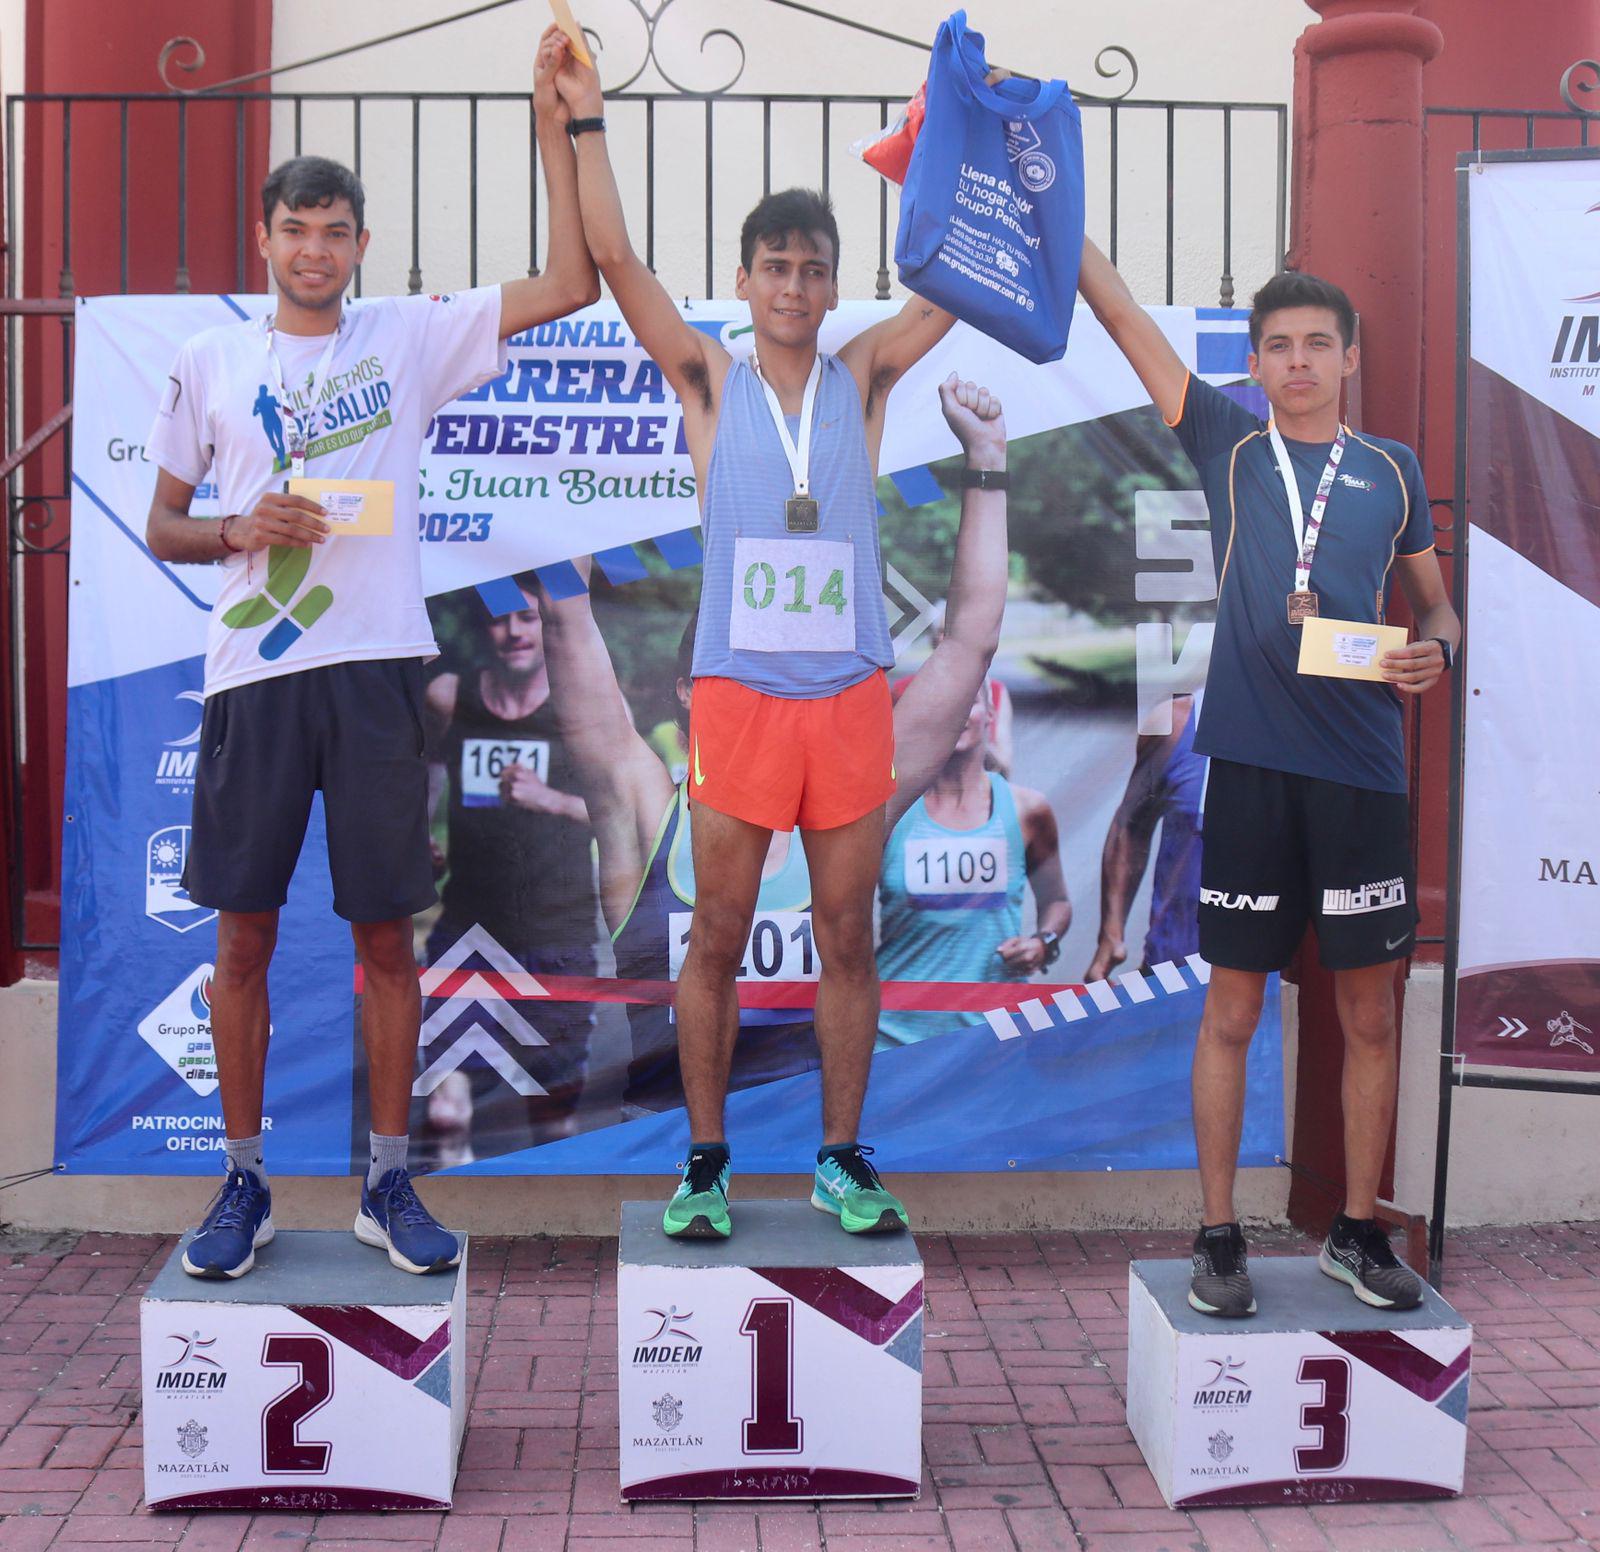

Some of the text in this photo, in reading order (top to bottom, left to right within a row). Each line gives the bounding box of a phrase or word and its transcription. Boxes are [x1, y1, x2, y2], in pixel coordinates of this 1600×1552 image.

[958, 177, 970, 192] tu
[972, 184, 1008, 207] hogar
[960, 163, 996, 187] Llena
[998, 180, 1012, 195] de
[955, 191, 993, 216] Grupo
[323, 381, 391, 431] SALUD
[446, 468, 550, 501] Juan
[743, 562, 848, 616] 014
[470, 745, 539, 779] 1671
[917, 850, 998, 884] 1109
[158, 1023, 195, 1037] Grupo
[187, 1042, 212, 1053] gas
[632, 1346, 703, 1363] IMDEM
[156, 1372, 228, 1389] IMDEM
[739, 1297, 804, 1456] 1
[261, 1333, 335, 1476] 2
[1193, 1390, 1252, 1405] IMDEM
[1293, 1355, 1353, 1474] 3
[633, 1434, 703, 1447] MAZATLÁN
[157, 1461, 230, 1473] MAZATLÁN
